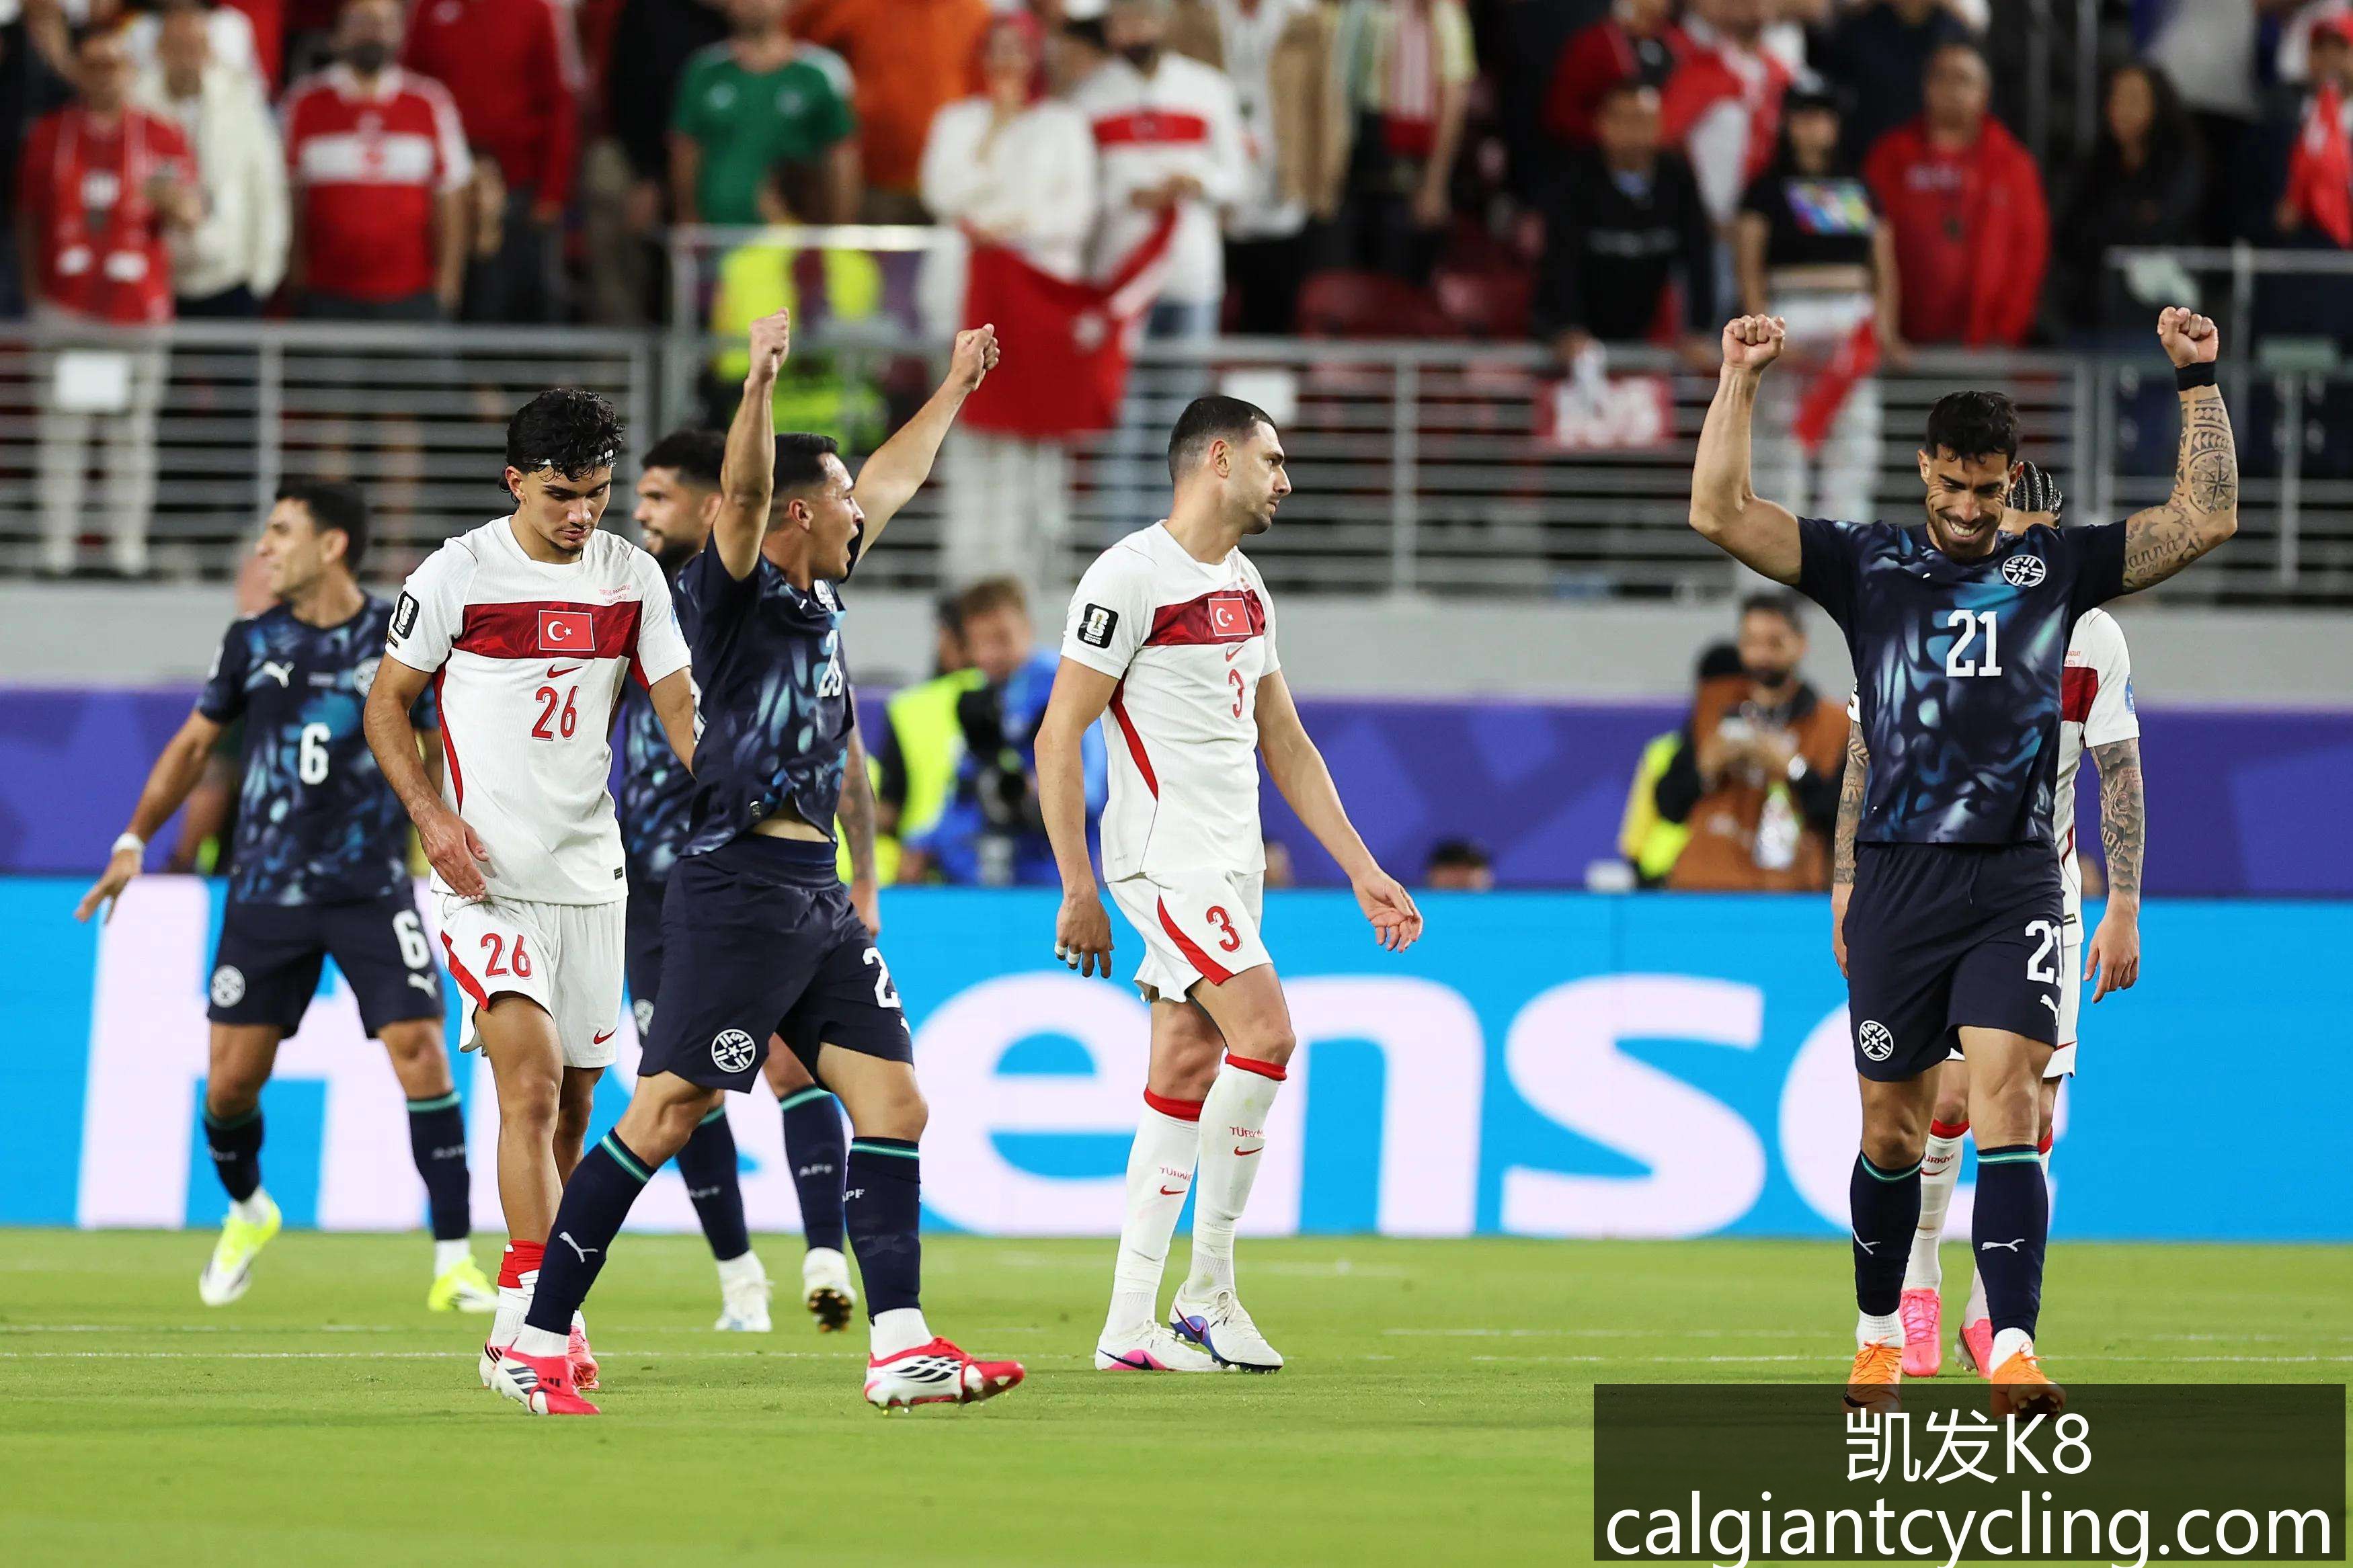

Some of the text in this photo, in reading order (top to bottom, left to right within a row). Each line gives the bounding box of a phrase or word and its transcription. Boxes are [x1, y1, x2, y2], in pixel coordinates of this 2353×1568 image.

[1946, 608, 2003, 677] 21
[531, 686, 580, 741] 26
[1228, 669, 1244, 721] 3
[300, 722, 331, 785] 6
[393, 909, 432, 970] 6
[480, 932, 533, 981] 26
[1205, 905, 1243, 953] 3
[2025, 919, 2063, 990] 21
